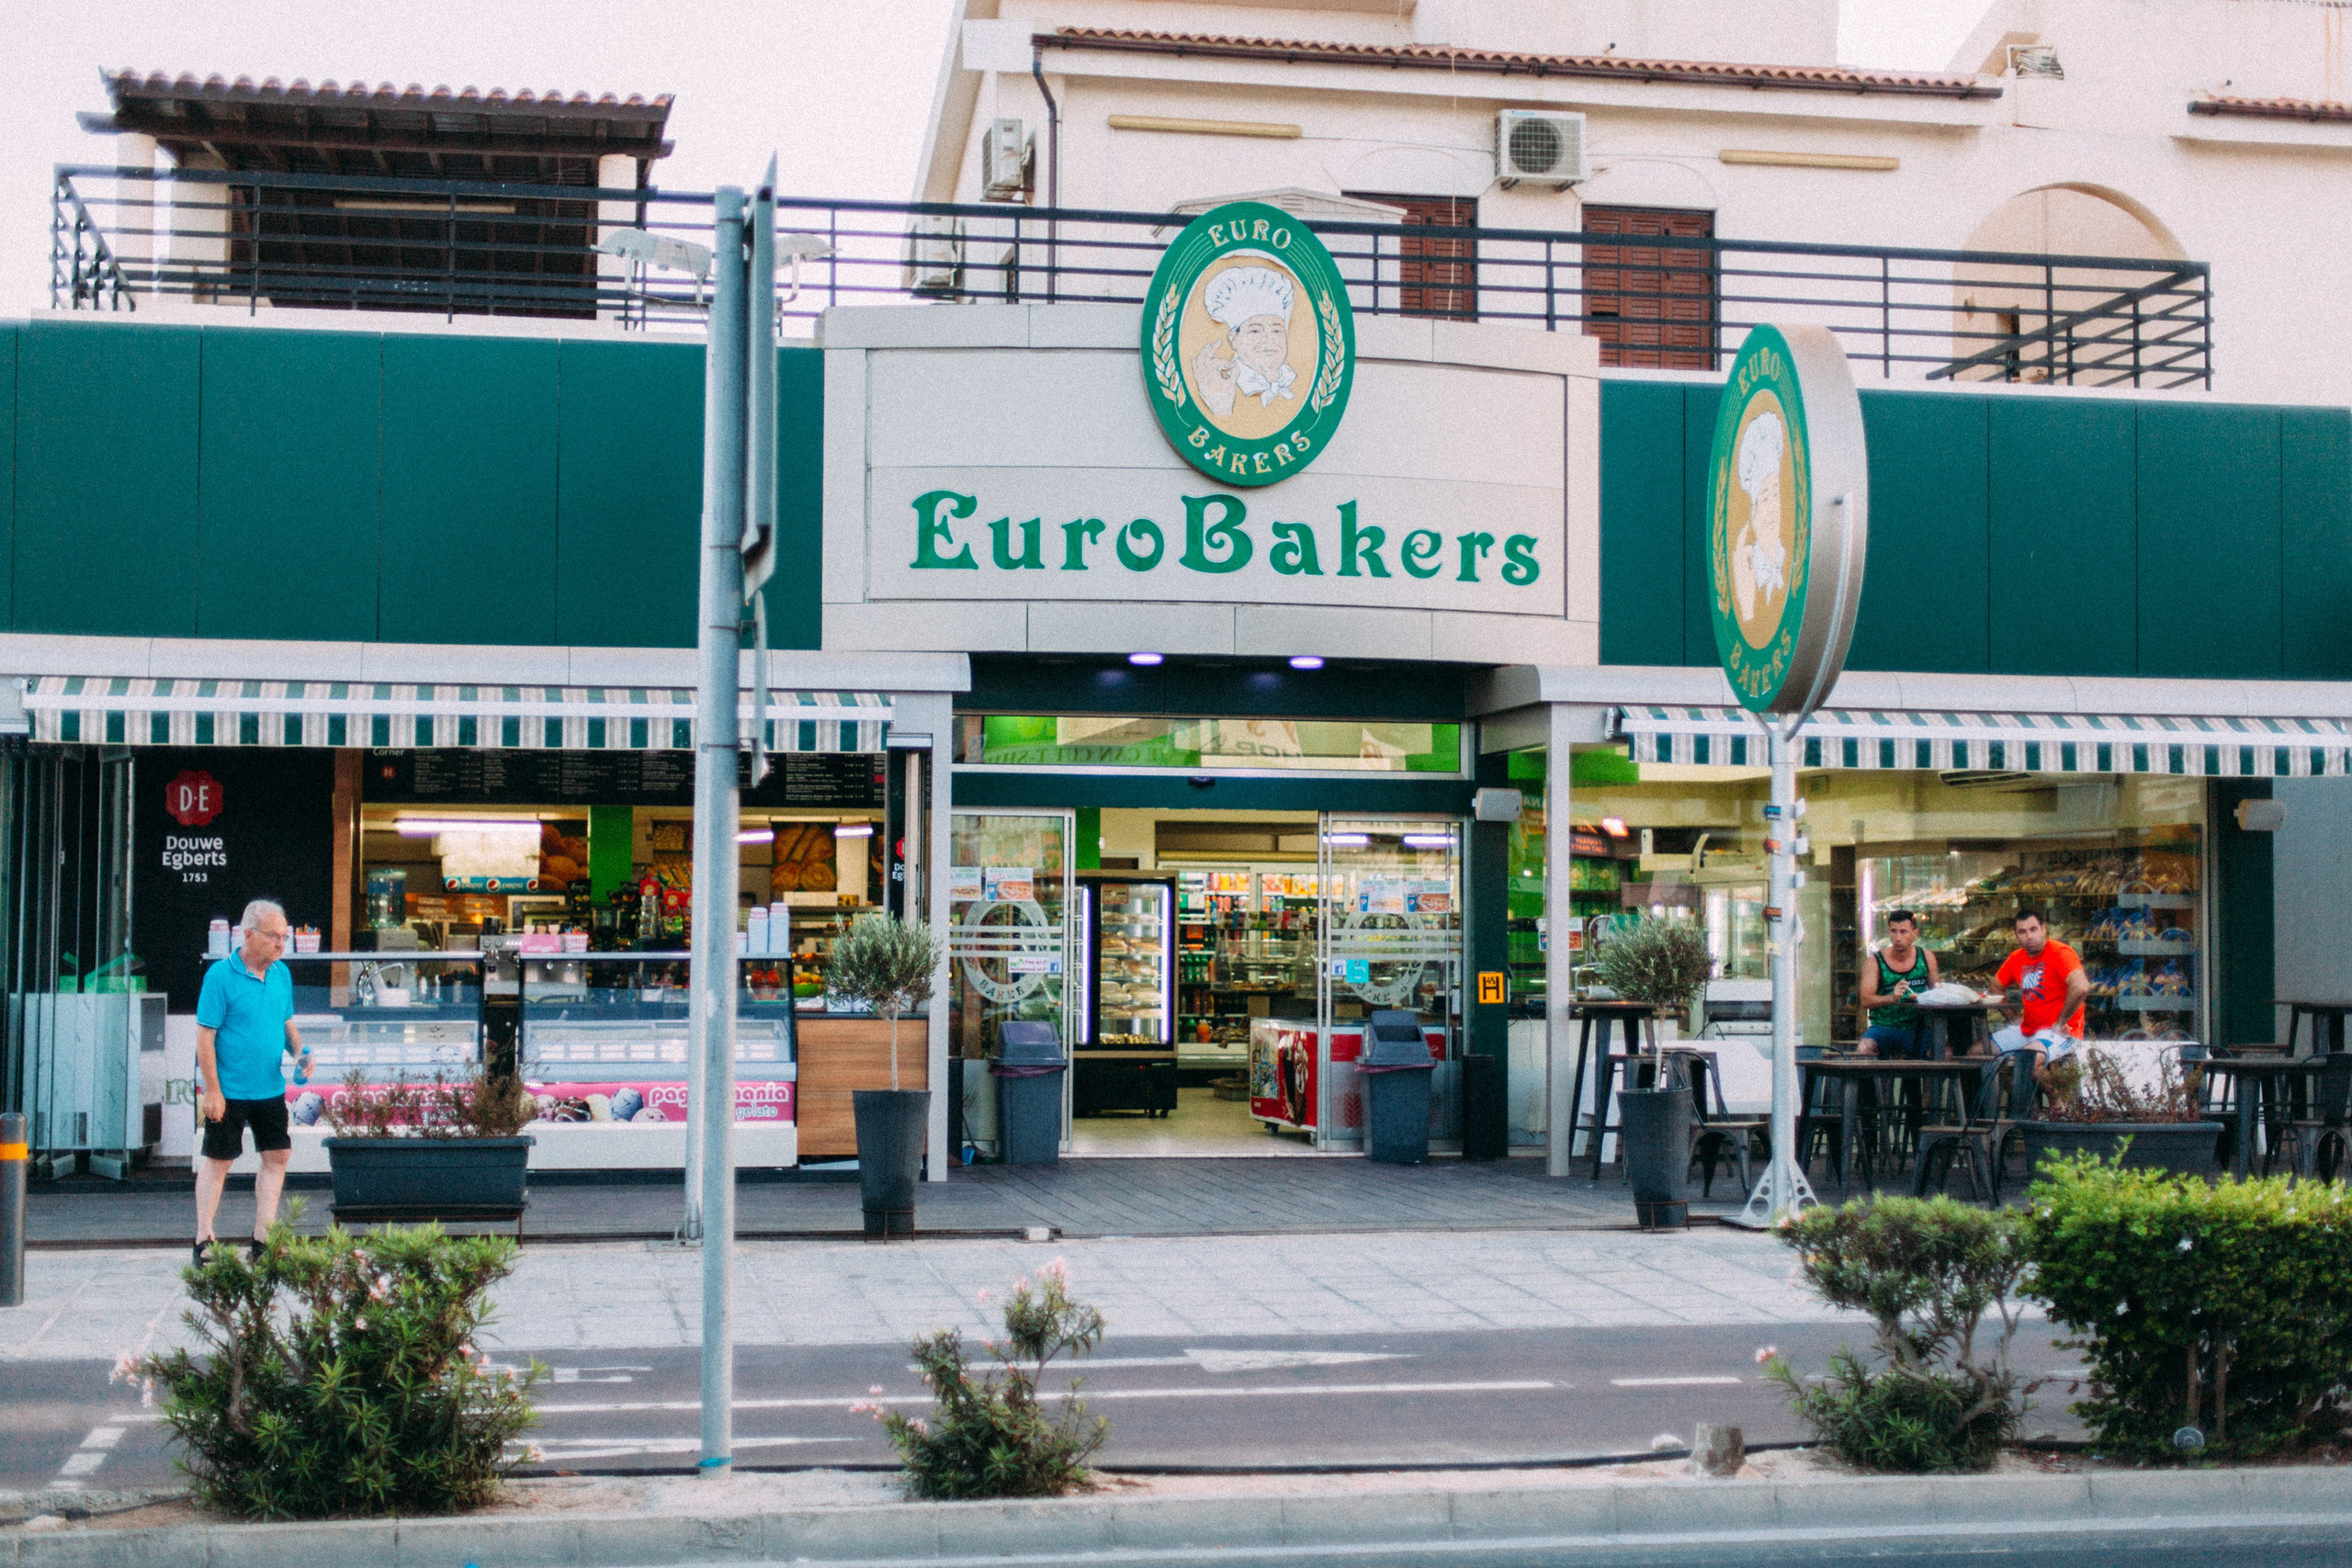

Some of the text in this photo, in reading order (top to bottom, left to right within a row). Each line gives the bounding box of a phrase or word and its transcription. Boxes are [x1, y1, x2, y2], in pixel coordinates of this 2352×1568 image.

[1208, 219, 1292, 250] EURO
[1737, 345, 1781, 399] EURO
[1188, 424, 1312, 476] BAKERS
[910, 490, 1541, 586] EuroBakers
[1729, 626, 1791, 698] BAKERS
[372, 748, 405, 756] Corner
[165, 835, 223, 850] Douwe
[162, 851, 227, 870] Egberts
[182, 873, 208, 882] 1753
[1482, 976, 1499, 999] H
[1486, 976, 1496, 985] 45
[735, 1103, 778, 1120] gelato
